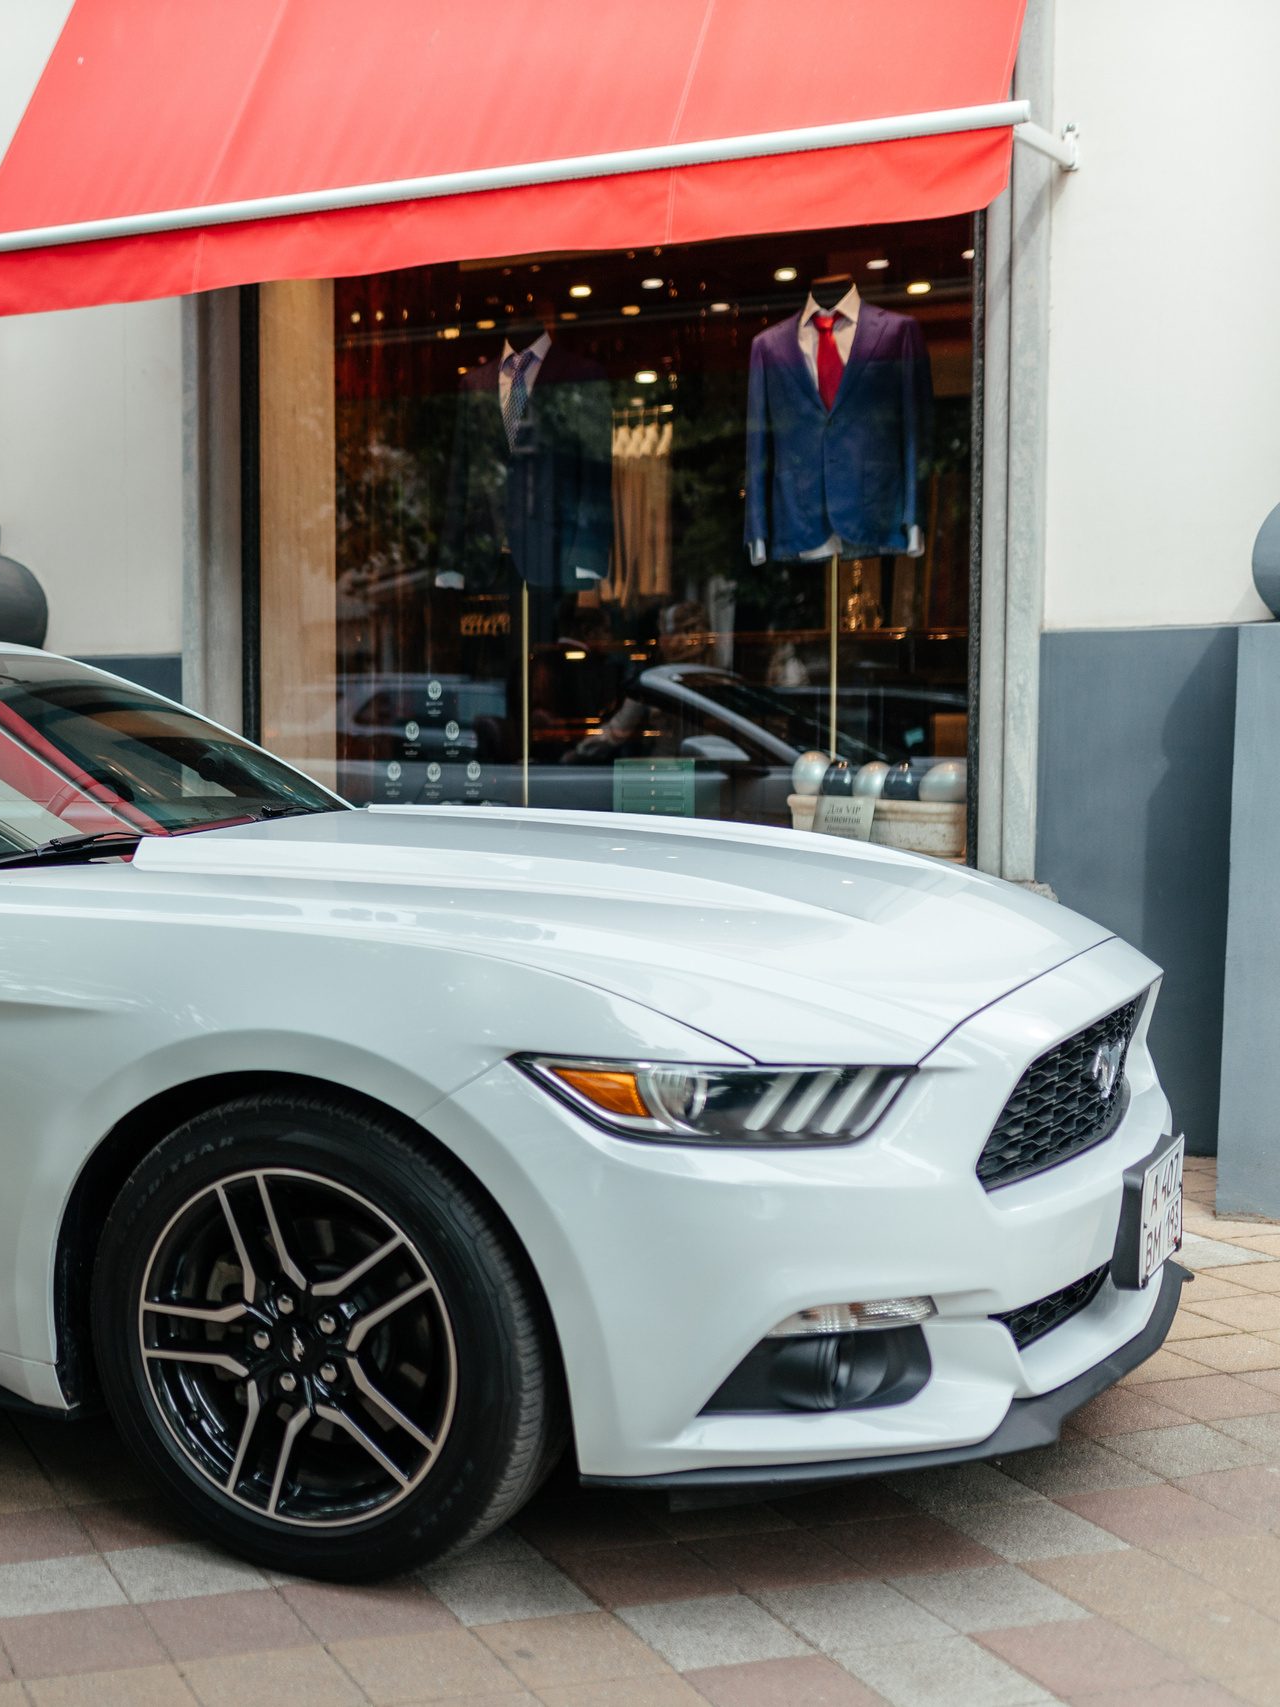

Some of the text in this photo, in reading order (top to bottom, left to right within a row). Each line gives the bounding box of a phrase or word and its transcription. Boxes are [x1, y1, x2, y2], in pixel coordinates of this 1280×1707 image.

[824, 816, 861, 824] клиентов
[827, 804, 861, 815] Для VIP
[1161, 1152, 1180, 1203] 407
[1165, 1200, 1179, 1239] 193
